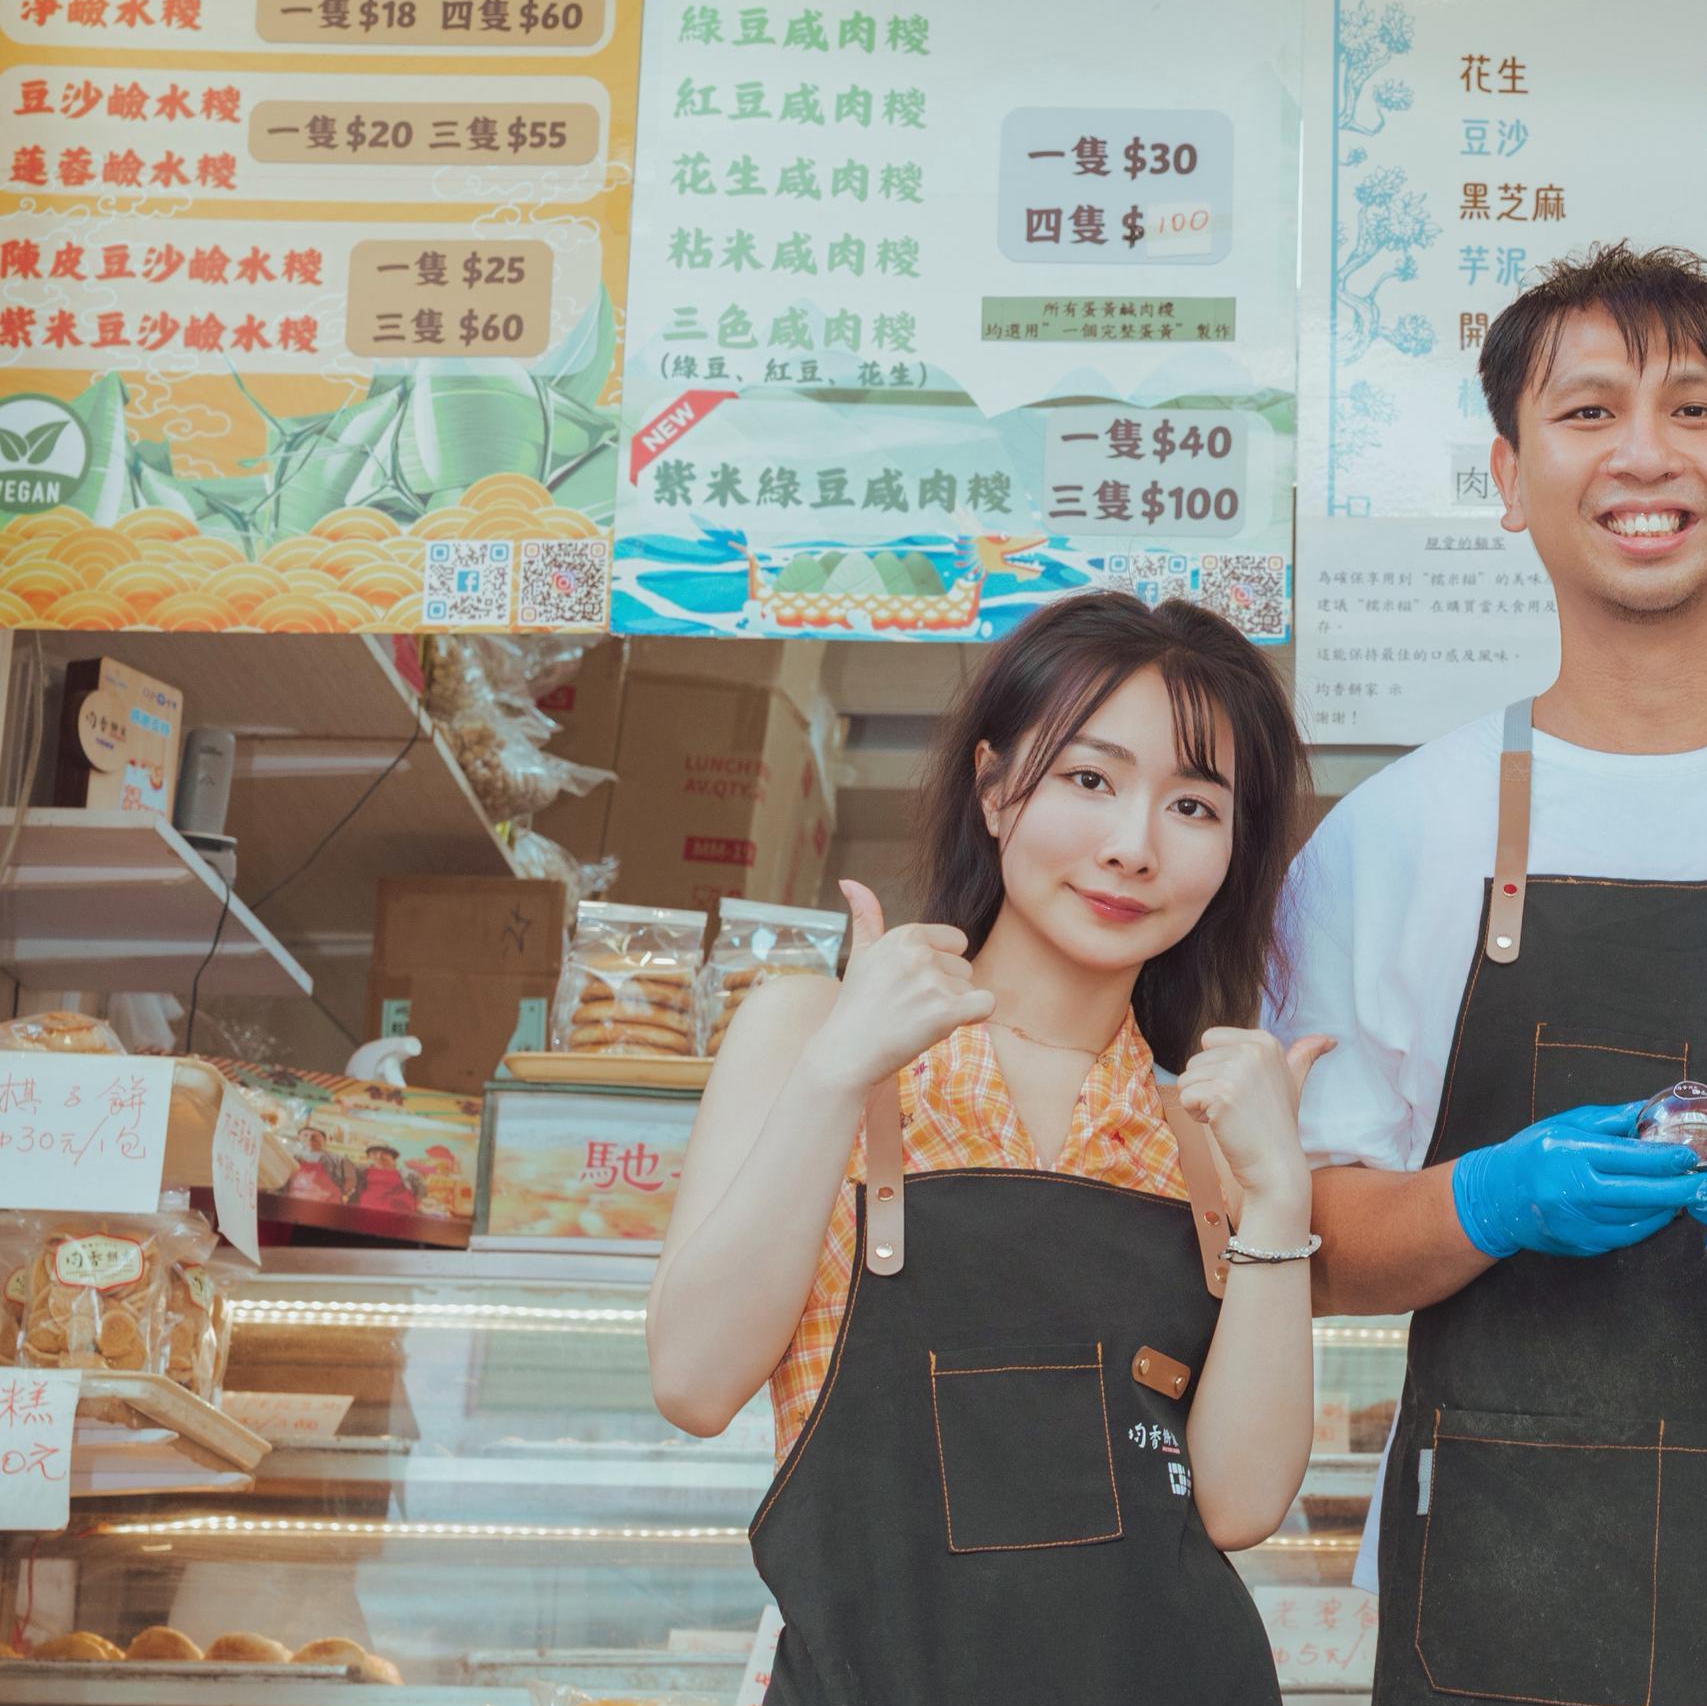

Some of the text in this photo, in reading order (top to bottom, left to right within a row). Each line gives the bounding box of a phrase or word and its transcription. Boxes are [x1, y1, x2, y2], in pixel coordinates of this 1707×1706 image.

[1460, 54, 1529, 94] 花生
[1123, 137, 1197, 180] $30
[1460, 118, 1529, 158] 豆沙
[1460, 182, 1567, 223] 黑芝麻
[462, 252, 526, 289] $25
[1458, 245, 1527, 288] 芋泥
[459, 309, 525, 346] $60
[640, 402, 697, 453] NEW
[579, 1140, 682, 1192] 馳
